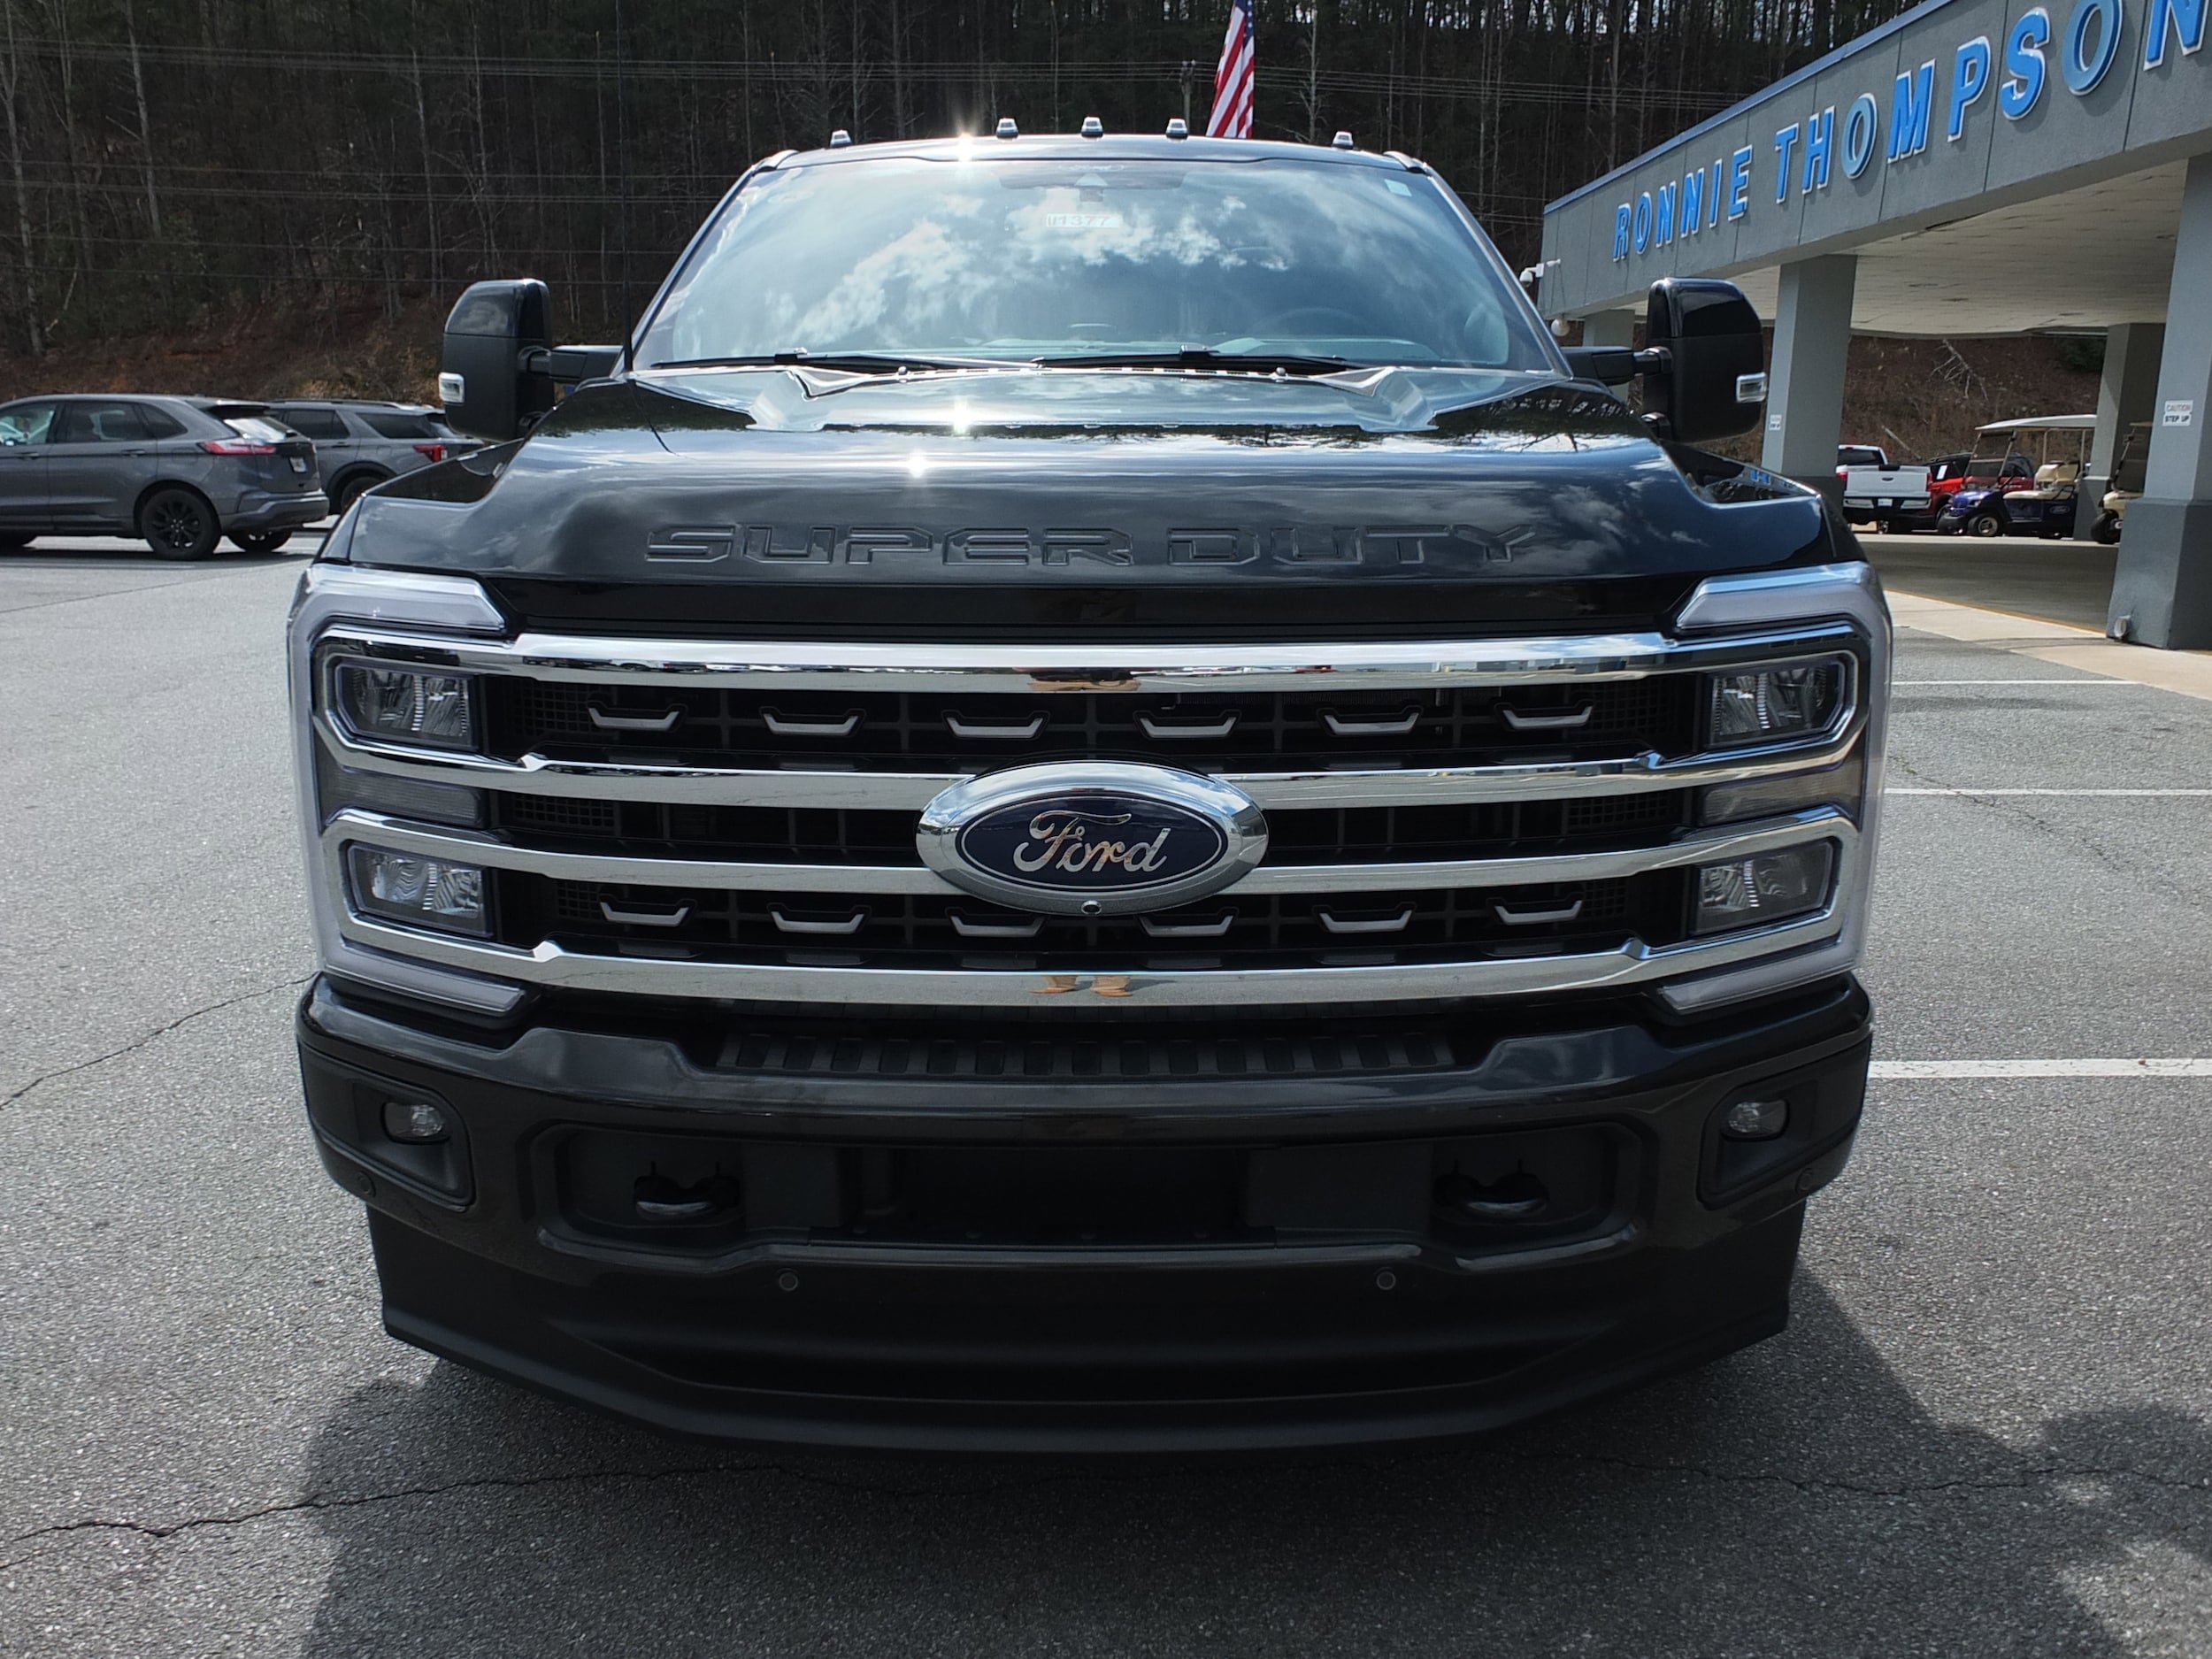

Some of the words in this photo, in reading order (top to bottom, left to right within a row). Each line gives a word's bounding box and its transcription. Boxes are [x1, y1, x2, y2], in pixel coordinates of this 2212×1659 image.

[1612, 143, 1753, 263] RONNIE
[1775, 0, 2209, 204] THOMPSON
[645, 526, 1133, 566] SUPER
[1167, 524, 1536, 566] DUTY
[1013, 810, 1171, 872] Ford
